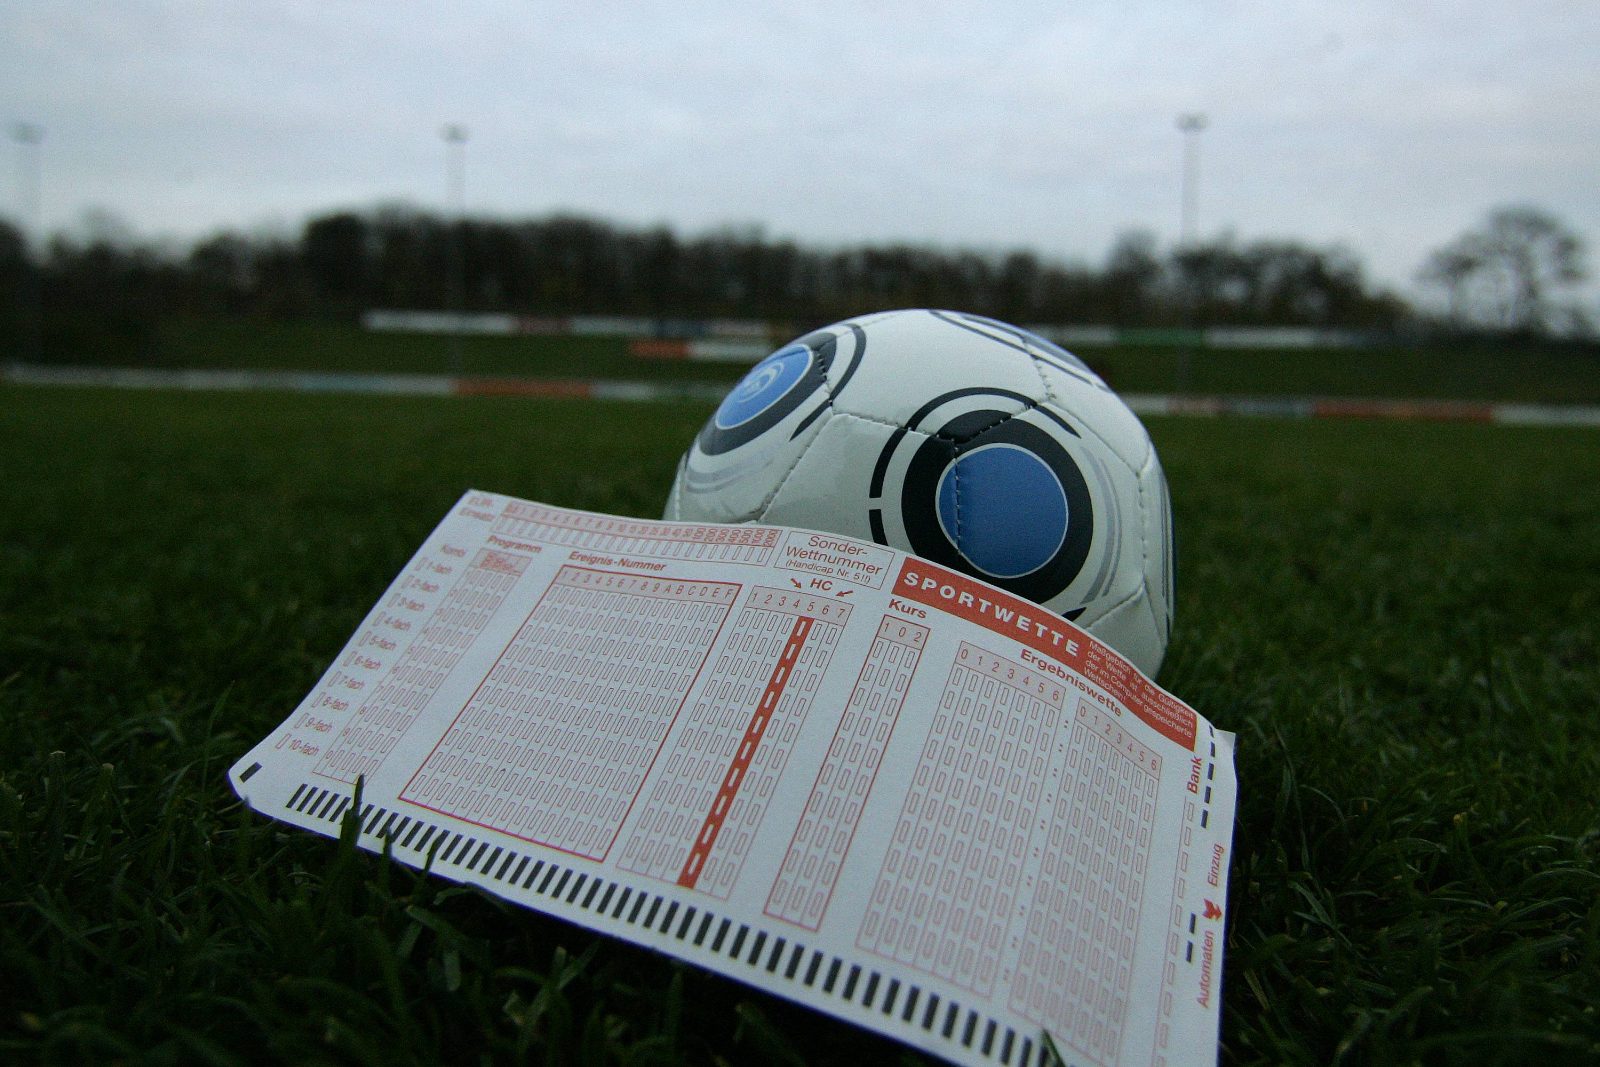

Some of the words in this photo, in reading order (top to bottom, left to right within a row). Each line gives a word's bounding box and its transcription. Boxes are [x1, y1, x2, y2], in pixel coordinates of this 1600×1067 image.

[487, 535, 542, 553] Programm
[808, 535, 868, 556] Sonder-
[785, 559, 834, 574] (Handicap
[837, 567, 850, 578] Nr.
[786, 545, 883, 575] Wettnummer
[810, 578, 833, 591] HC
[753, 592, 758, 602] 1
[764, 594, 773, 604] 2
[779, 596, 787, 607] 3
[793, 599, 800, 609] 4
[806, 601, 815, 612] 5
[822, 605, 830, 615] 6
[837, 608, 845, 618] 7
[889, 598, 927, 619] Kurs
[903, 571, 1079, 657] SPORTWETTE
[884, 622, 890, 632] 1
[899, 626, 907, 637] 0
[913, 632, 922, 642] 2
[1087, 650, 1100, 661] der
[960, 648, 968, 659] 0
[978, 656, 983, 665] 1
[992, 661, 1000, 672] 2
[1008, 668, 1015, 679] 3
[1023, 676, 1030, 685] 4
[1038, 682, 1045, 693] 5
[1052, 690, 1060, 701] 6
[1020, 648, 1122, 717] Ergebniswette
[1085, 660, 1098, 670] der
[1110, 675, 1143, 706] Computer
[305, 717, 333, 733] 9-fach
[289, 738, 320, 756] 10-fach
[1187, 755, 1202, 794] Bank
[1207, 843, 1225, 888] Einzug
[1197, 929, 1214, 1009] Automaten
